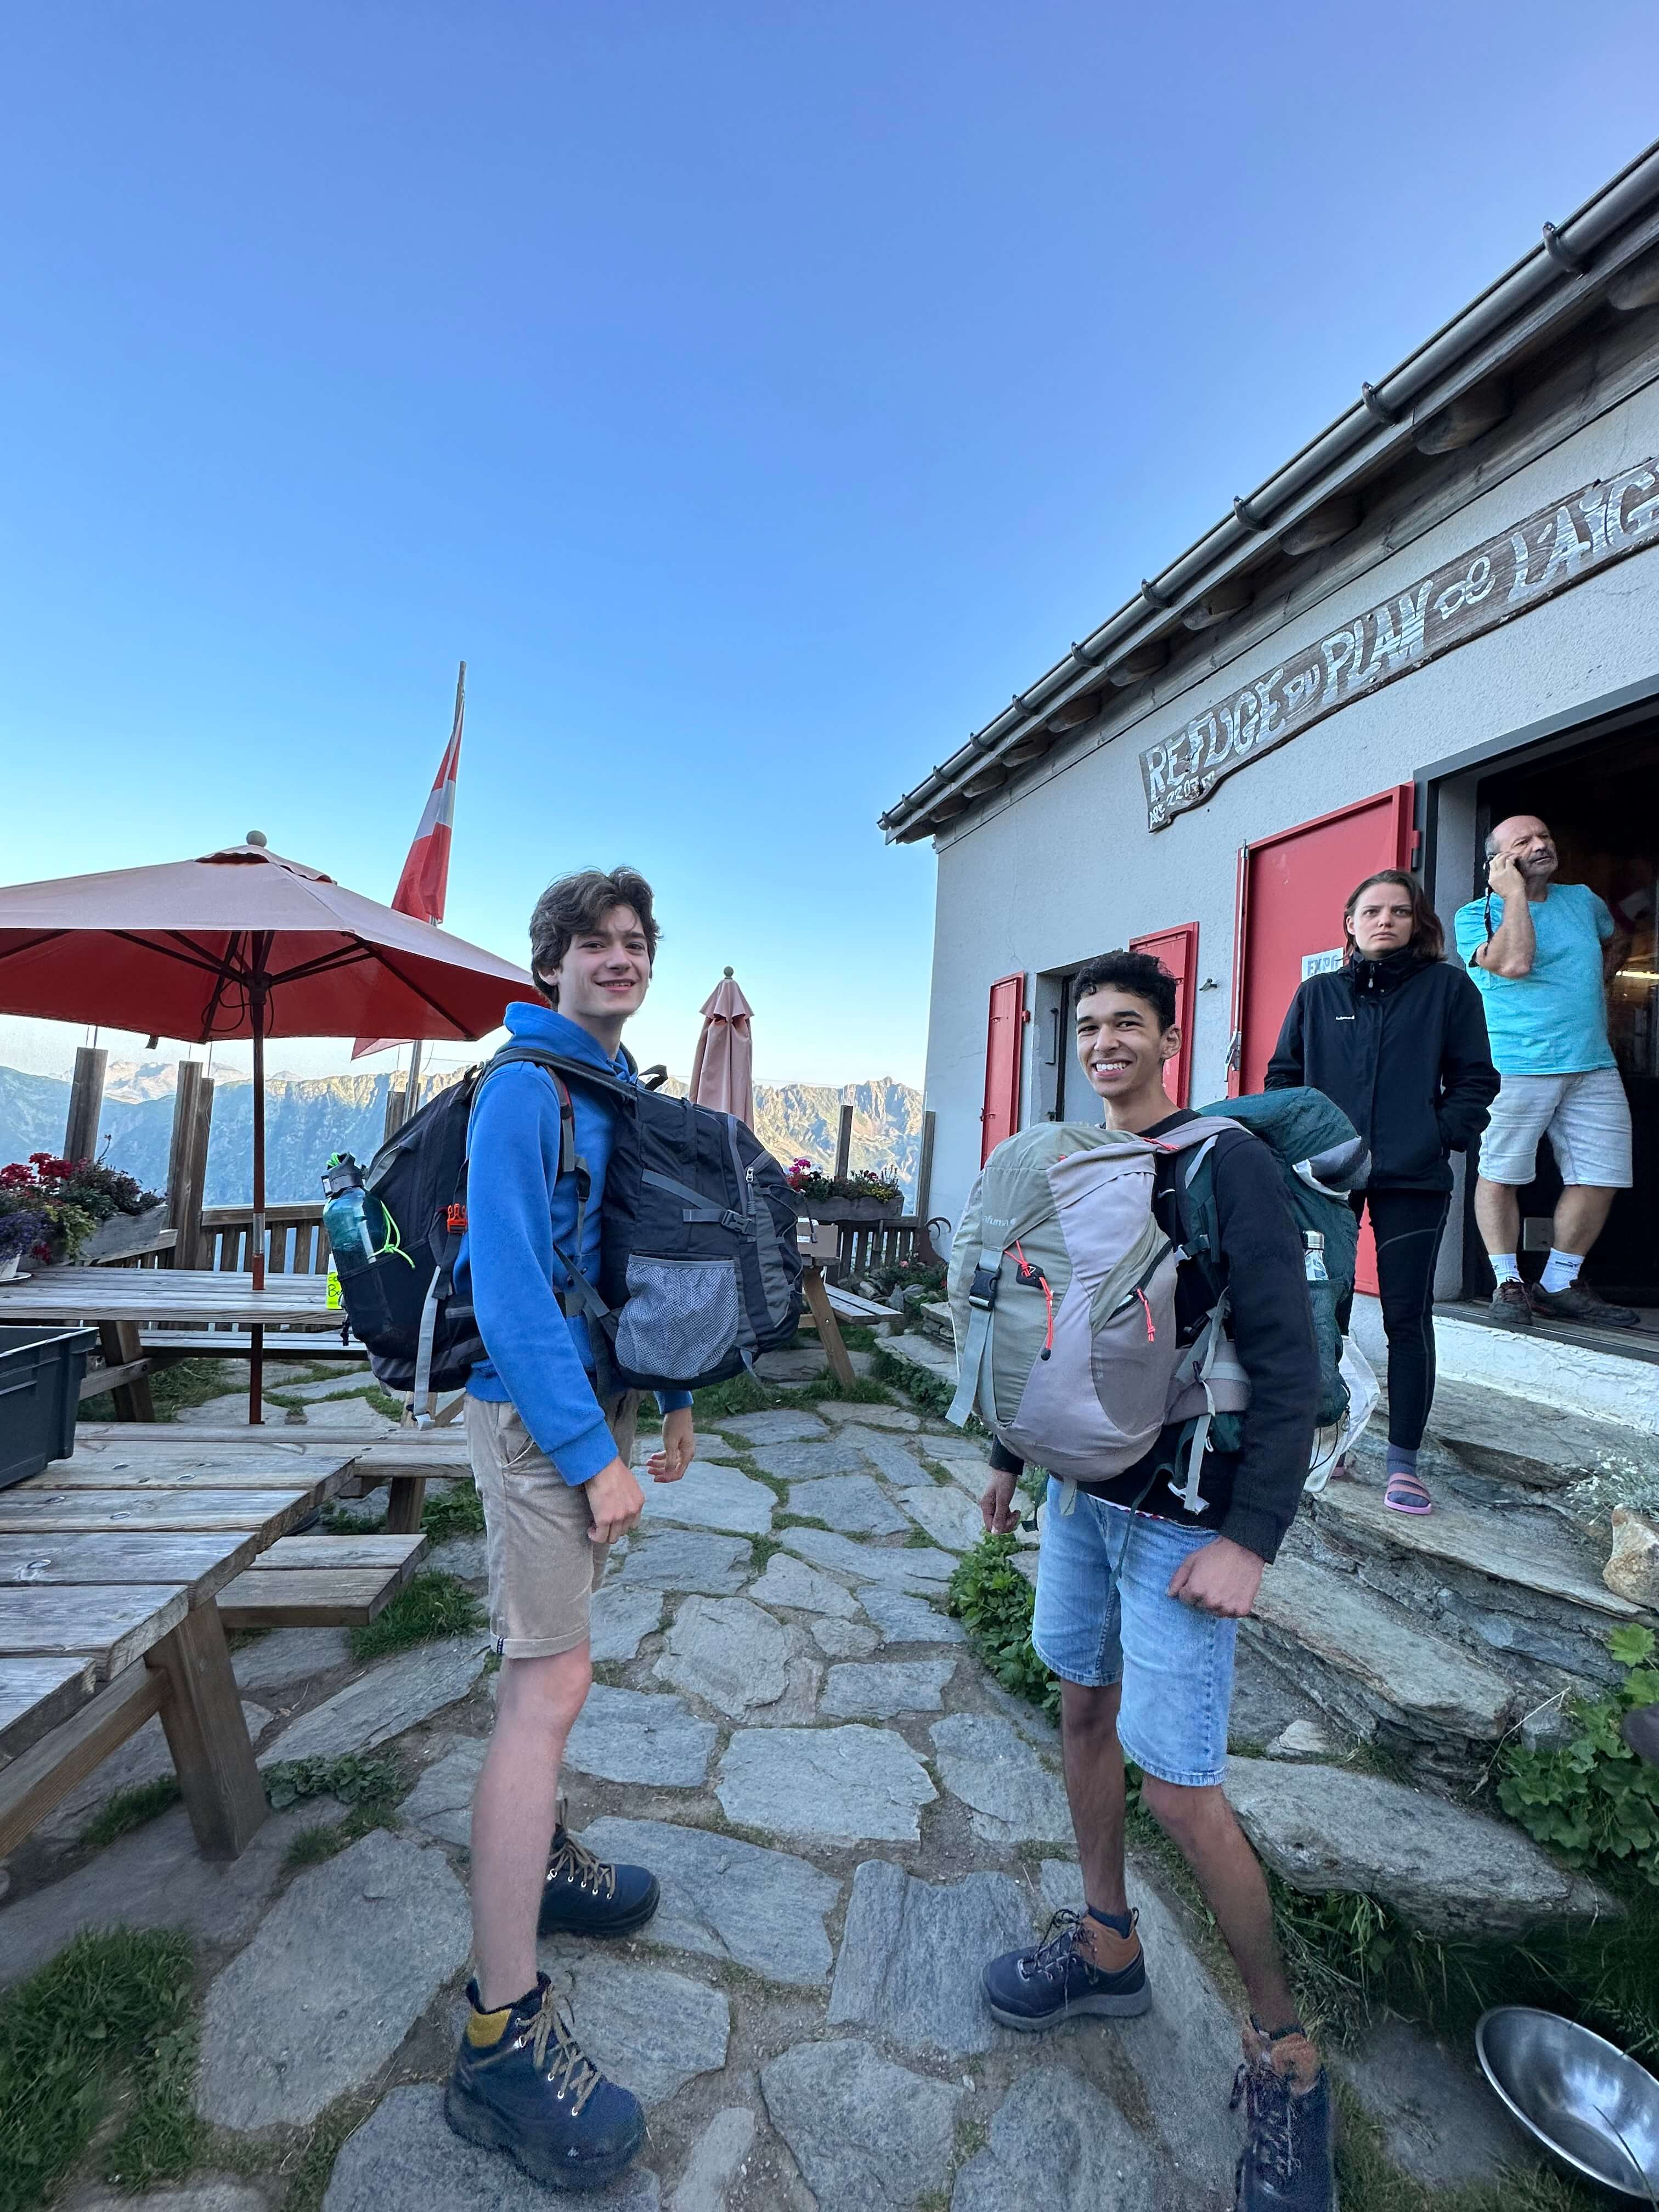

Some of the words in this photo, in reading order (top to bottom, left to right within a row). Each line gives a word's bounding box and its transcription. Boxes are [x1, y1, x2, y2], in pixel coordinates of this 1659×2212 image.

[1145, 668, 1286, 802] REFUGE
[1321, 579, 1433, 704] PLAN
[983, 1215, 1009, 1227] afuma
